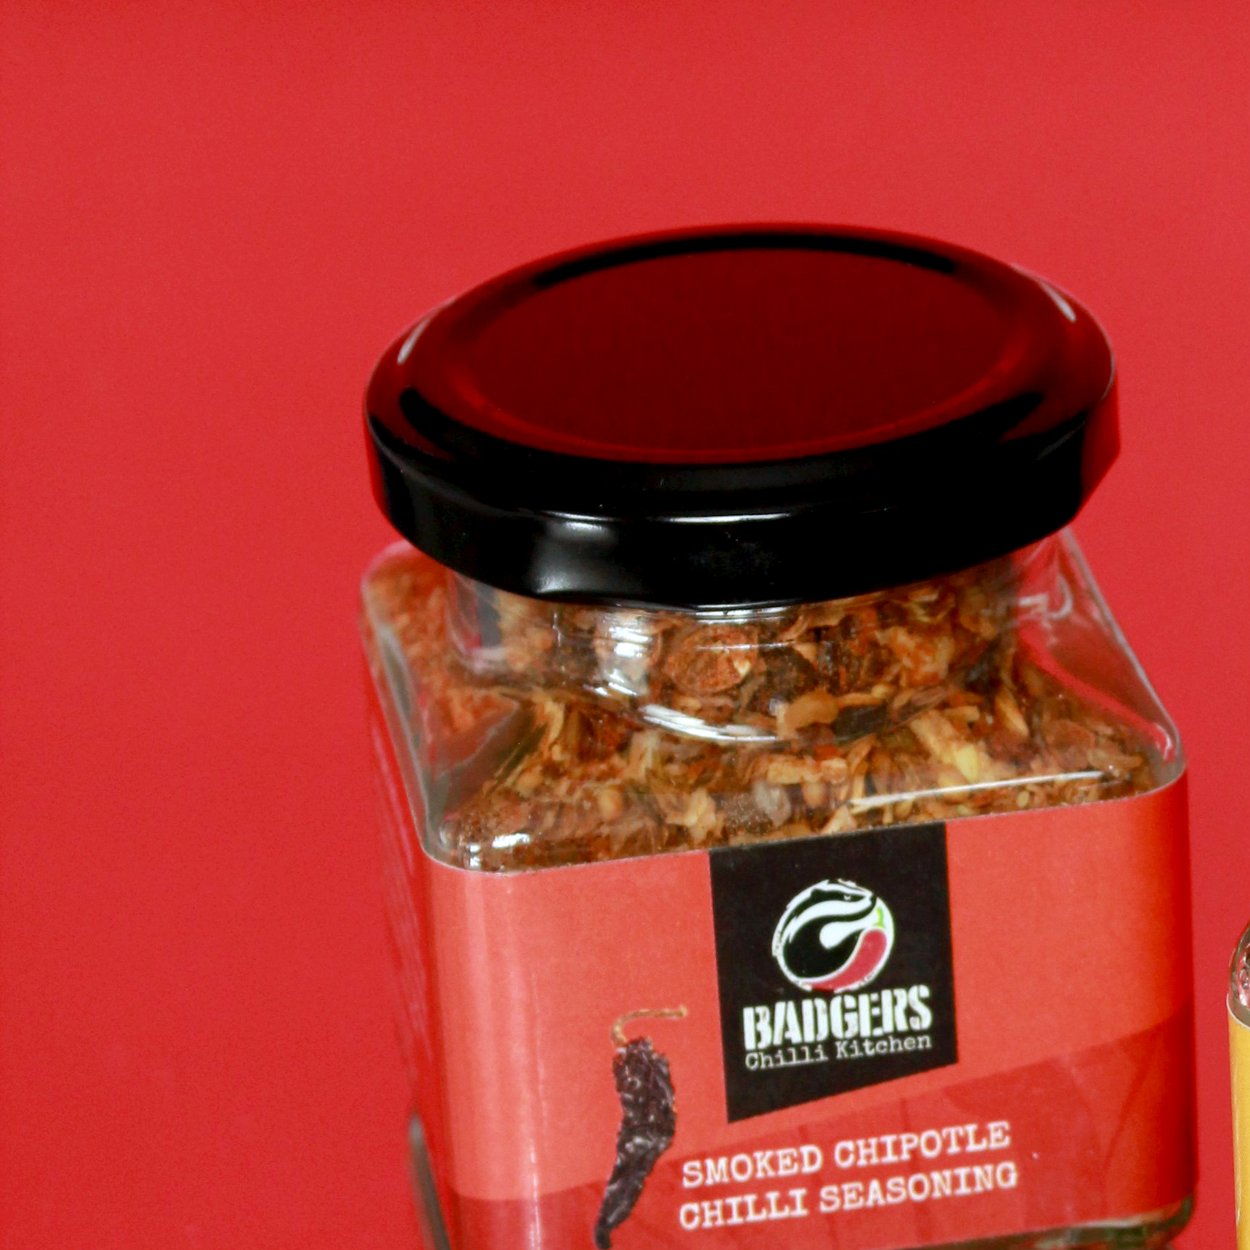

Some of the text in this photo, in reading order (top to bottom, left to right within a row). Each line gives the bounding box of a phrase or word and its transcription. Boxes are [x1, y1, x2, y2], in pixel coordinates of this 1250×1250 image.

[743, 984, 932, 1050] BADGERS
[744, 1034, 932, 1070] Chilli Kitchen
[682, 1122, 1011, 1188] SMOKED CHIPOTLE
[679, 1162, 1018, 1230] CHILLI SEASONING
